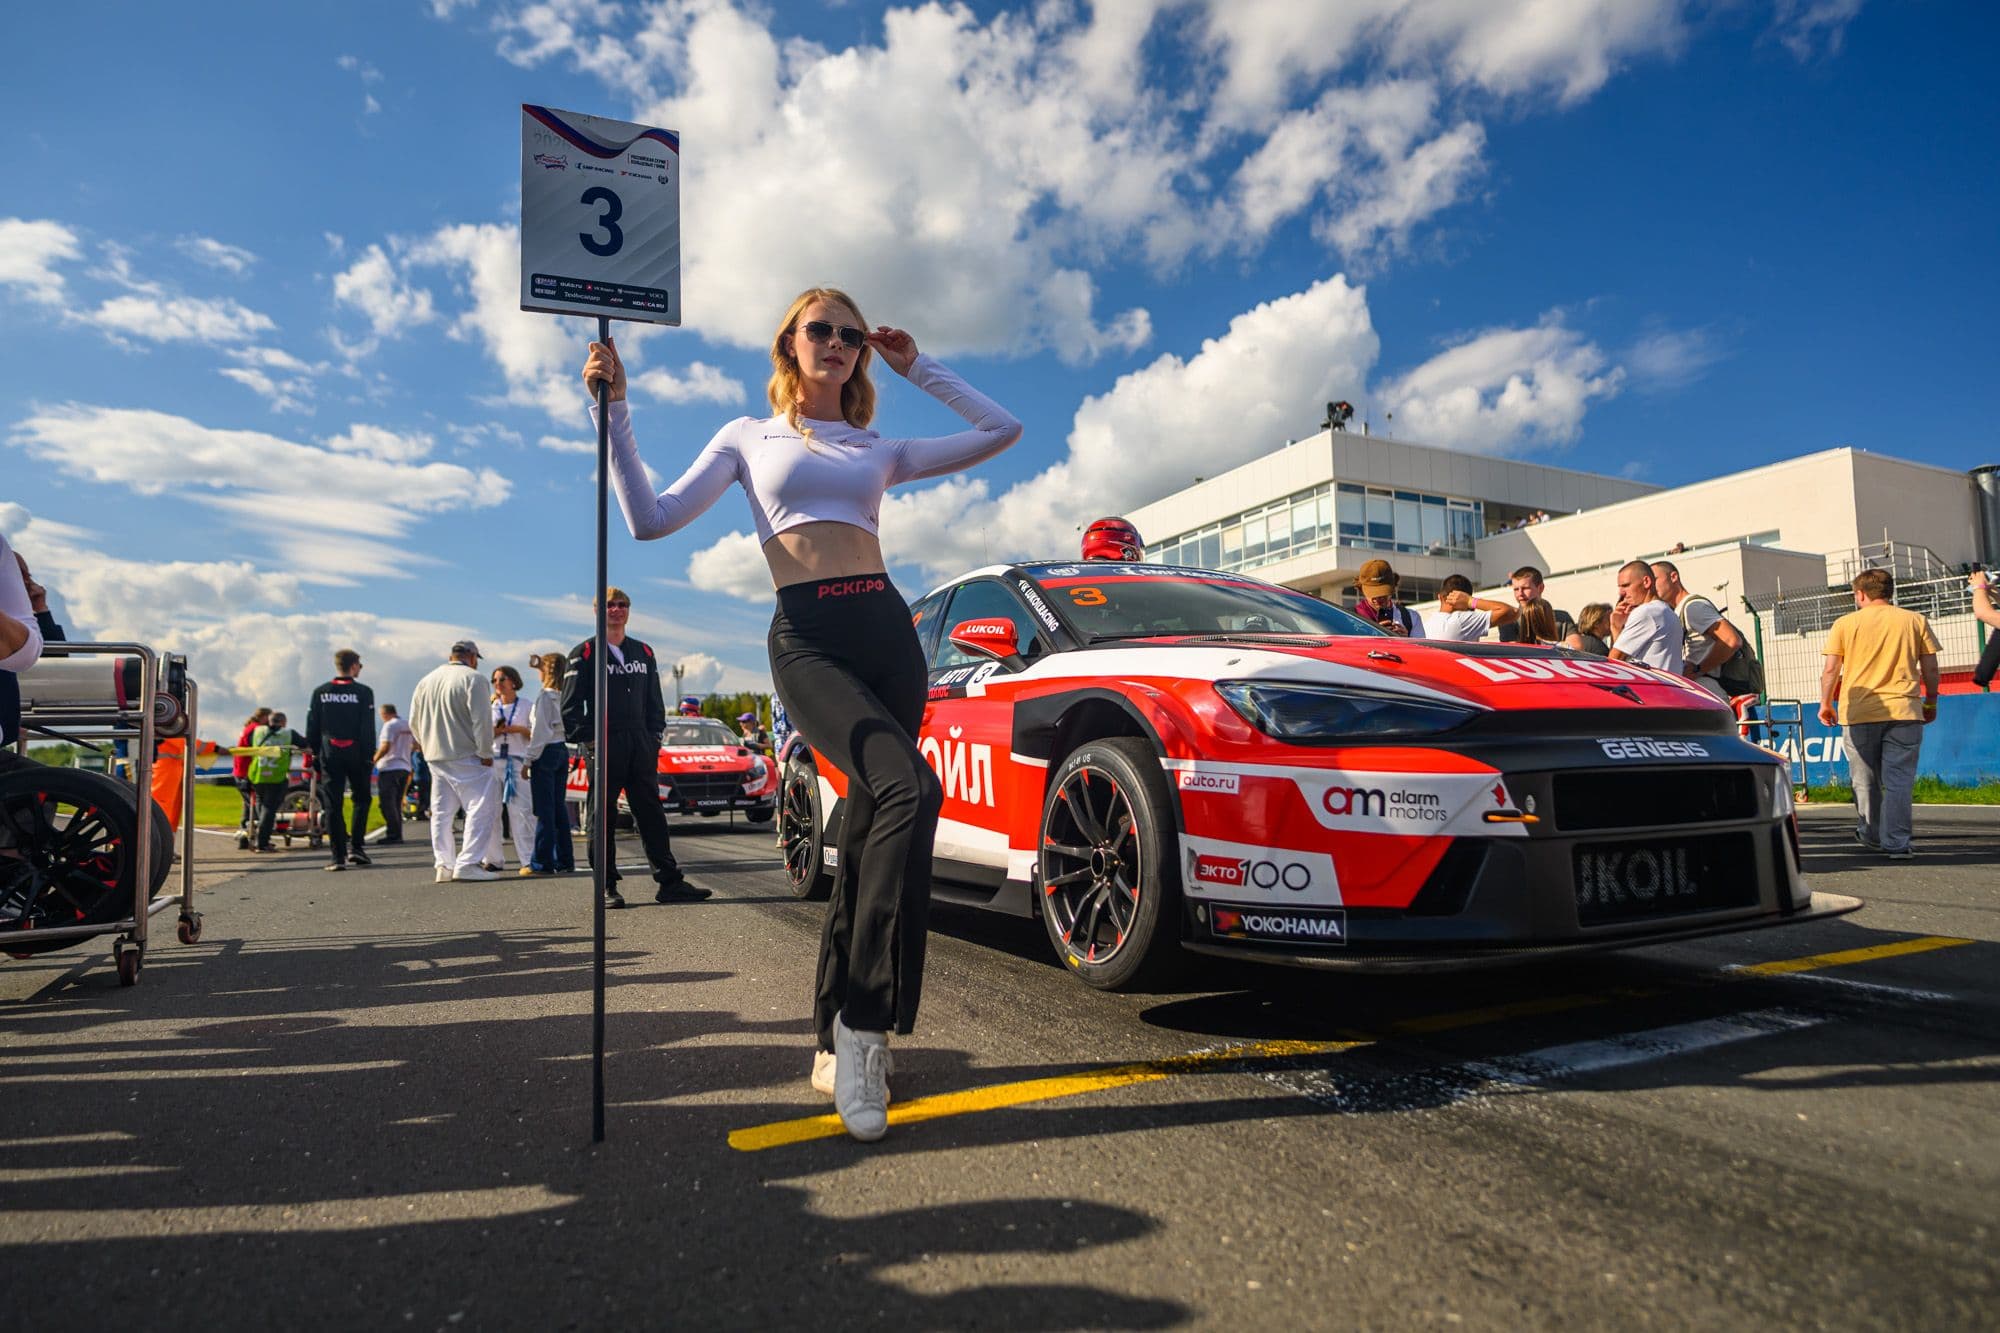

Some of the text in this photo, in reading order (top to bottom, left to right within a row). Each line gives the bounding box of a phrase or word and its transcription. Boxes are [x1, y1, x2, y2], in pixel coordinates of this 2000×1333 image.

[579, 186, 623, 256] 3
[817, 579, 885, 600] РСКГ.РФ
[1069, 587, 1108, 606] 3
[966, 625, 1005, 635] LUKOIL
[607, 660, 647, 675] УКОЙЛ
[974, 667, 992, 683] 3
[320, 692, 360, 704] LUKOIL
[671, 755, 735, 764] LUKOIL
[1601, 742, 1710, 760] GENESIS
[917, 725, 995, 808] ОЙЛ
[1183, 776, 1235, 790] auto.ru
[697, 799, 728, 807] YOKOHAMA
[1390, 789, 1440, 806] alarm
[1389, 805, 1448, 822] motors
[1200, 859, 1311, 891] ЭКТО 100
[1240, 916, 1341, 937] YOKOHAMA
